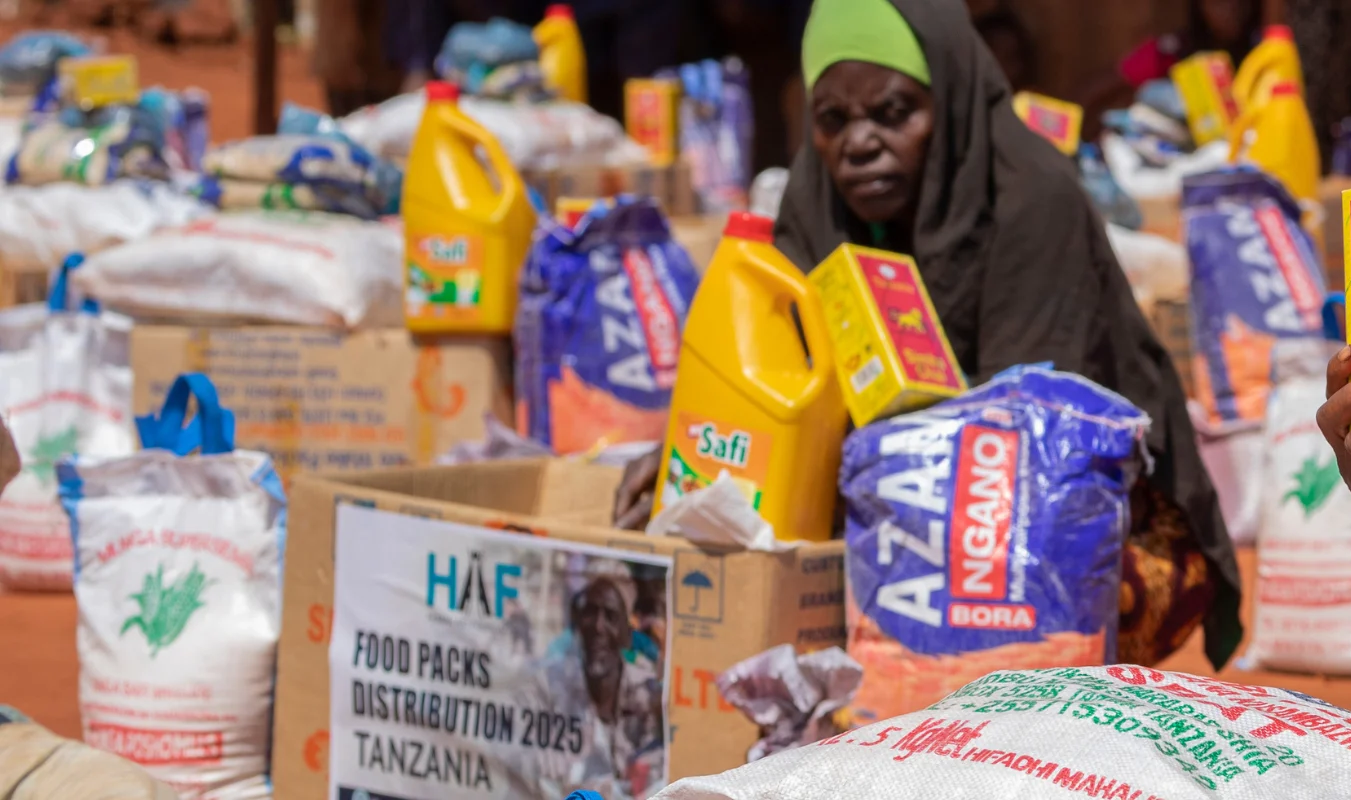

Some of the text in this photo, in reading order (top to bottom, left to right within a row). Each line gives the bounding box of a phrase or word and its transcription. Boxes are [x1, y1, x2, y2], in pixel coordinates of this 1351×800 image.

[699, 425, 749, 463] Safi
[962, 432, 1007, 594] NGANO
[951, 604, 1033, 628] BORA
[354, 630, 490, 689] FOOD PACKS
[352, 679, 584, 755] DISTRIBUTION 2025
[354, 731, 494, 792] TANZANIA
